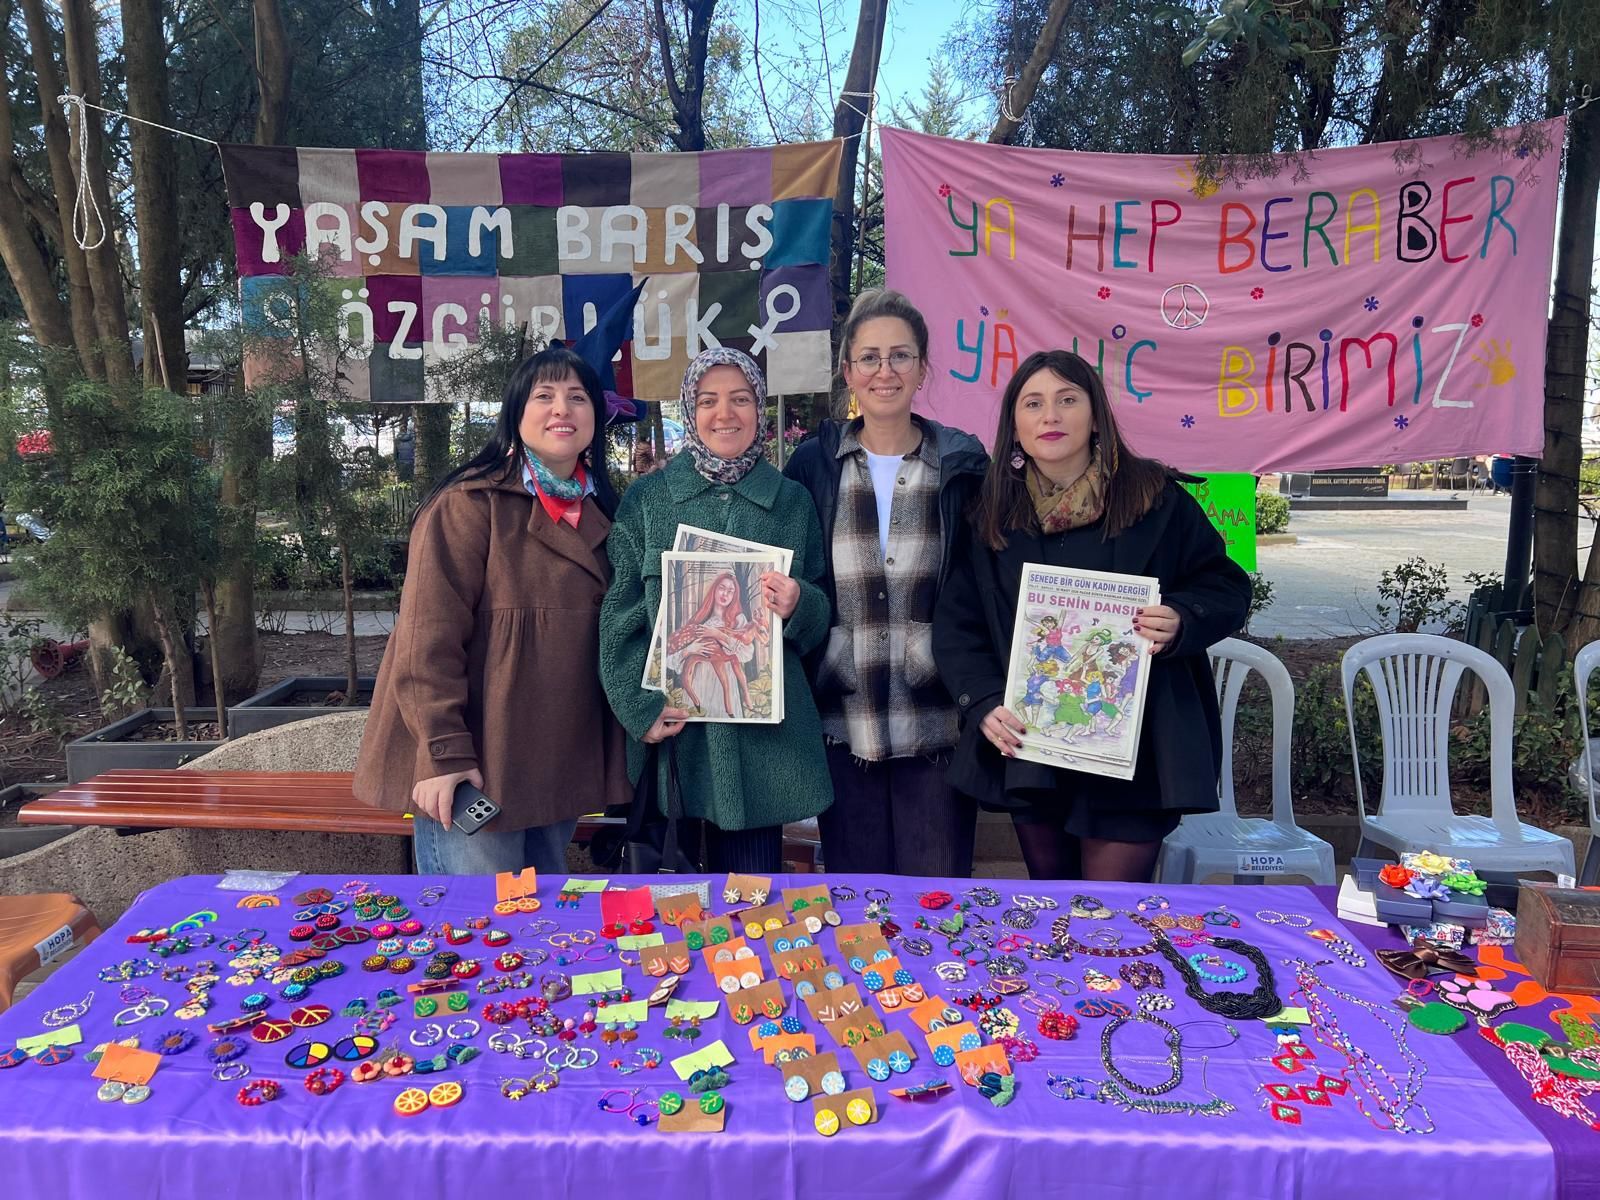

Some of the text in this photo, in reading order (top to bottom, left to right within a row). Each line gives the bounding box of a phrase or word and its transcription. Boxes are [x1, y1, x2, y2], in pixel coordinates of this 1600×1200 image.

[249, 201, 774, 271] YAŞAM BARIŞ
[948, 175, 1518, 274] YA HEP BERABER
[950, 318, 1019, 388] YA
[1217, 315, 1476, 418] BİRİMİZ
[1030, 573, 1058, 585] SENEDE
[1060, 576, 1073, 587] BİR
[1074, 578, 1091, 589] GÜN
[1092, 581, 1117, 592] KADIN
[1117, 585, 1148, 597] DERGİSİ
[1027, 592, 1046, 604] BU
[1049, 594, 1090, 610] SENİN
[1250, 856, 1284, 865] HOPA
[47, 928, 71, 950] HOPA
